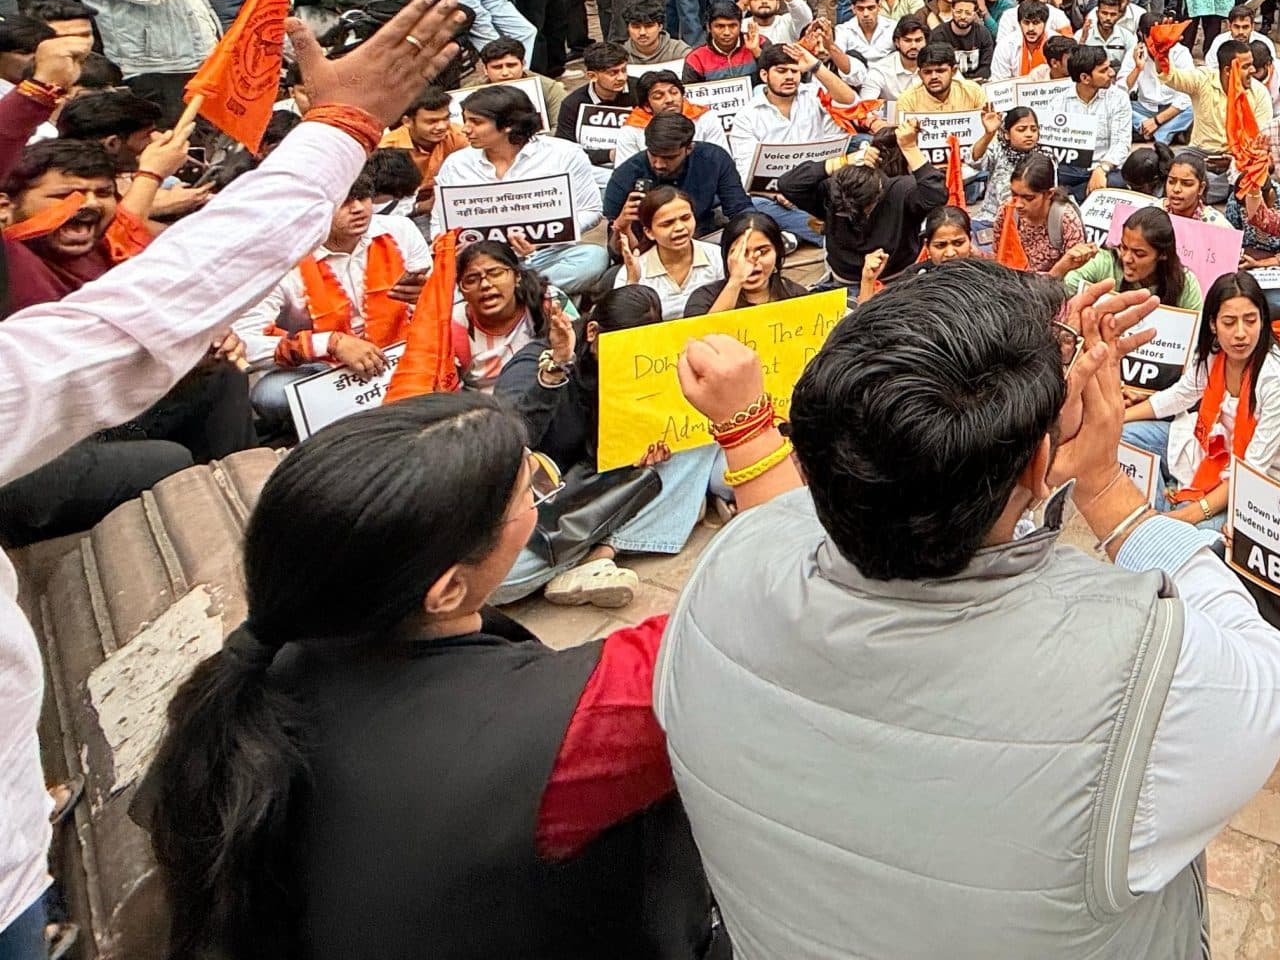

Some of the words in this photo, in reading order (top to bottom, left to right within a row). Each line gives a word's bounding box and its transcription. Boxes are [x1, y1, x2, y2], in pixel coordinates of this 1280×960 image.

[696, 86, 708, 96] की
[712, 84, 744, 96] आवाज
[764, 152, 791, 160] Voice
[452, 198, 466, 207] हम
[468, 196, 494, 205] अपना
[495, 192, 532, 203] अधिकार
[474, 206, 498, 216] किसी
[768, 322, 803, 344] The
[355, 383, 382, 405] शर्म
[1248, 500, 1270, 520] Down
[1236, 508, 1265, 534] Student
[1267, 529, 1280, 541] DU
